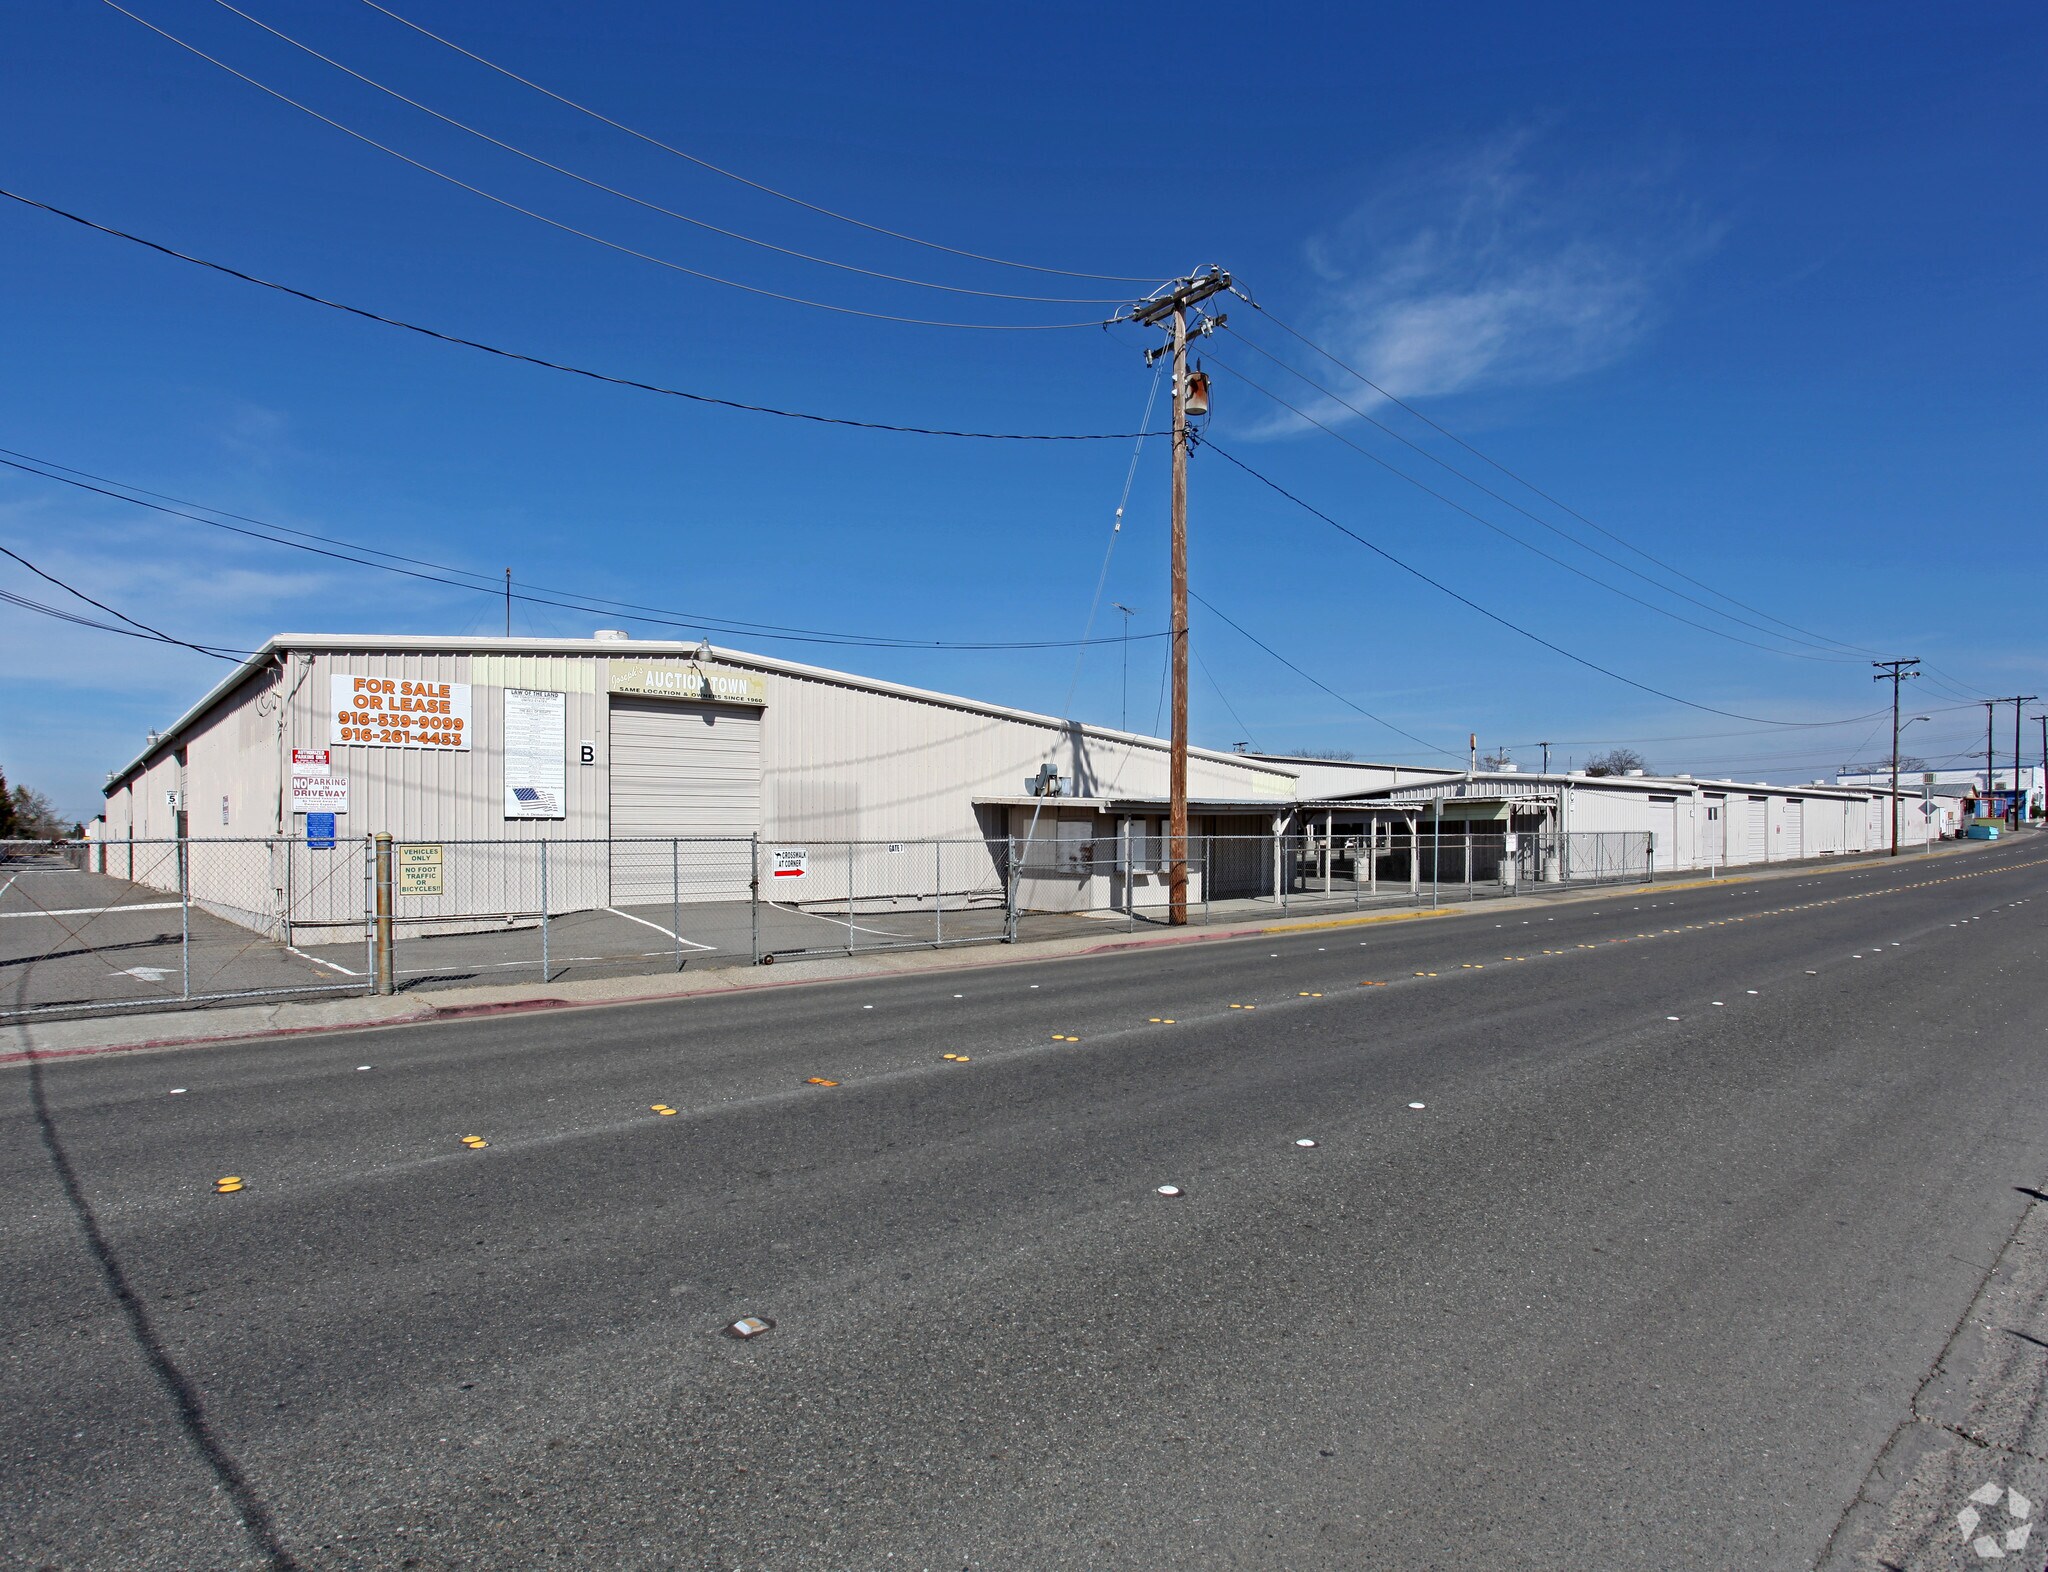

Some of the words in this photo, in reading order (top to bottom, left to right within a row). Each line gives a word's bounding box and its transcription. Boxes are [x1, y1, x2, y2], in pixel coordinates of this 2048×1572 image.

[611, 666, 643, 689] Joseph's
[645, 670, 706, 690] AUCTION
[711, 676, 747, 694] TOWN
[353, 678, 396, 695] FOR
[401, 682, 451, 698] SALE
[353, 695, 383, 710] OR
[389, 697, 451, 714] LEASE
[338, 711, 464, 731] 916-539-9099
[341, 728, 462, 746] 916-261-4453
[581, 746, 594, 762] B
[293, 778, 307, 789] NO
